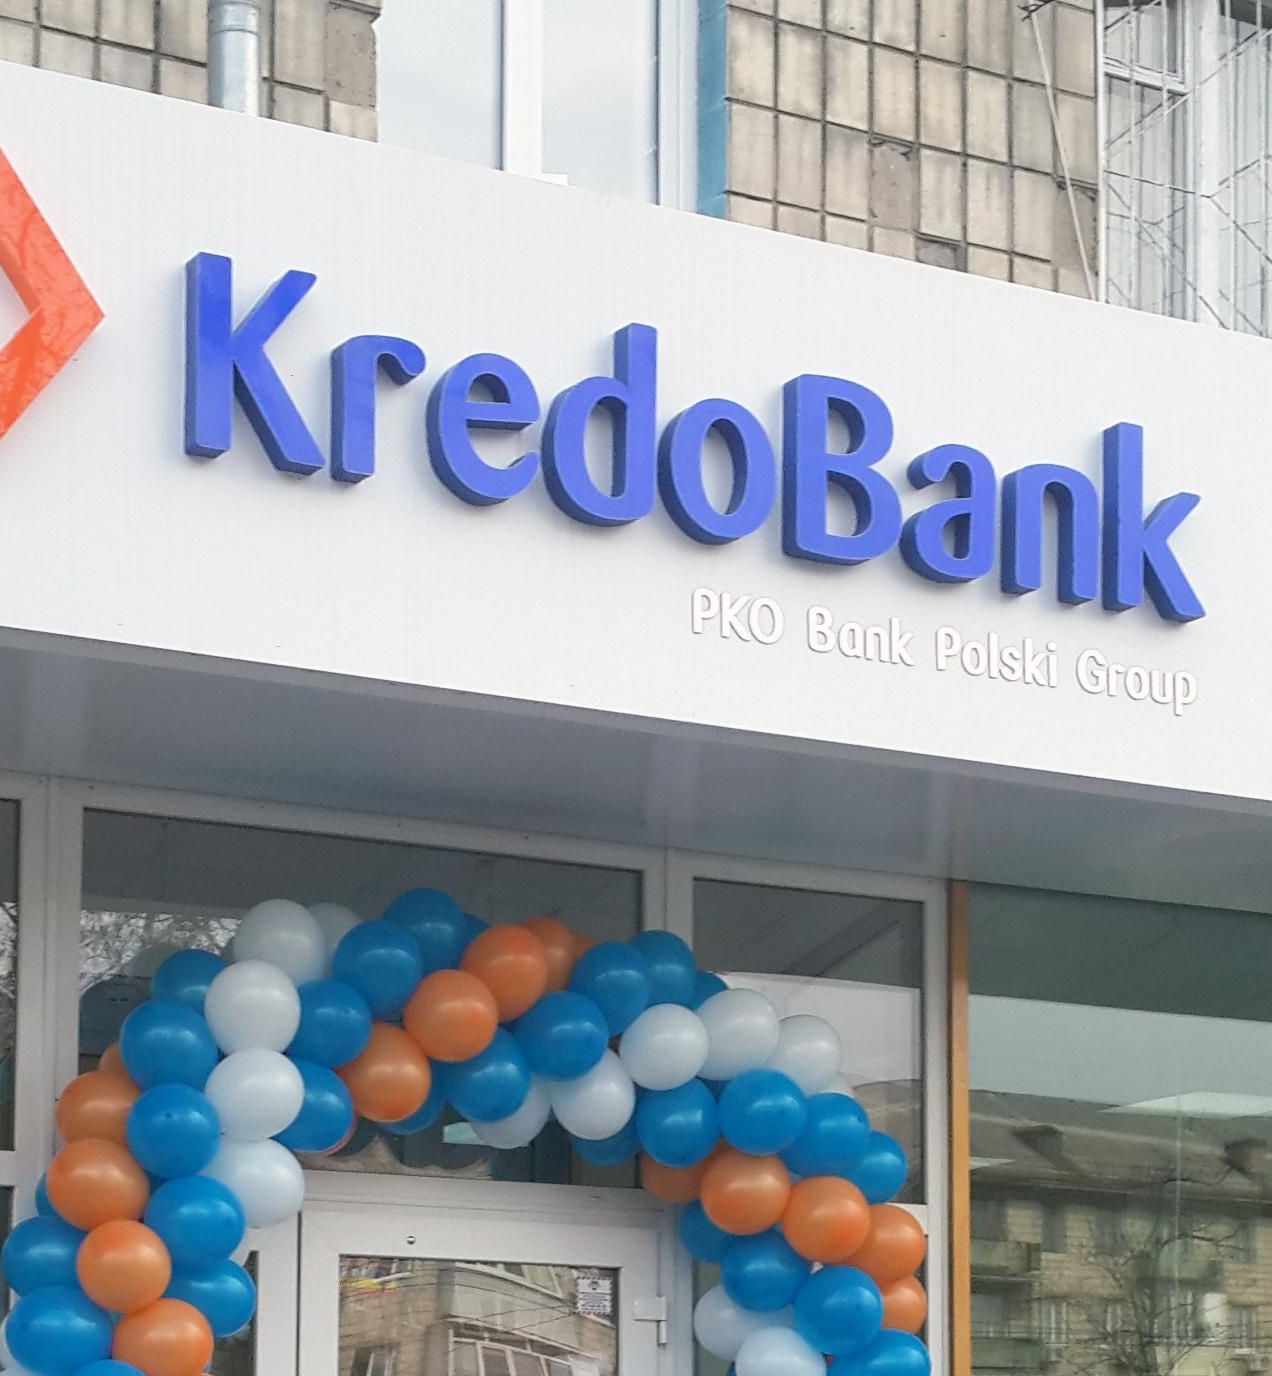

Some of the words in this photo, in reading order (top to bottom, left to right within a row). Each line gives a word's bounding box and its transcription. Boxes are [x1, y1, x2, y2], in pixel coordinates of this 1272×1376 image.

[183, 252, 1206, 624] KredoBank
[691, 588, 785, 644] PKO
[807, 605, 916, 667] Bank
[936, 627, 1059, 689] Polski
[1076, 648, 1198, 716] Group
